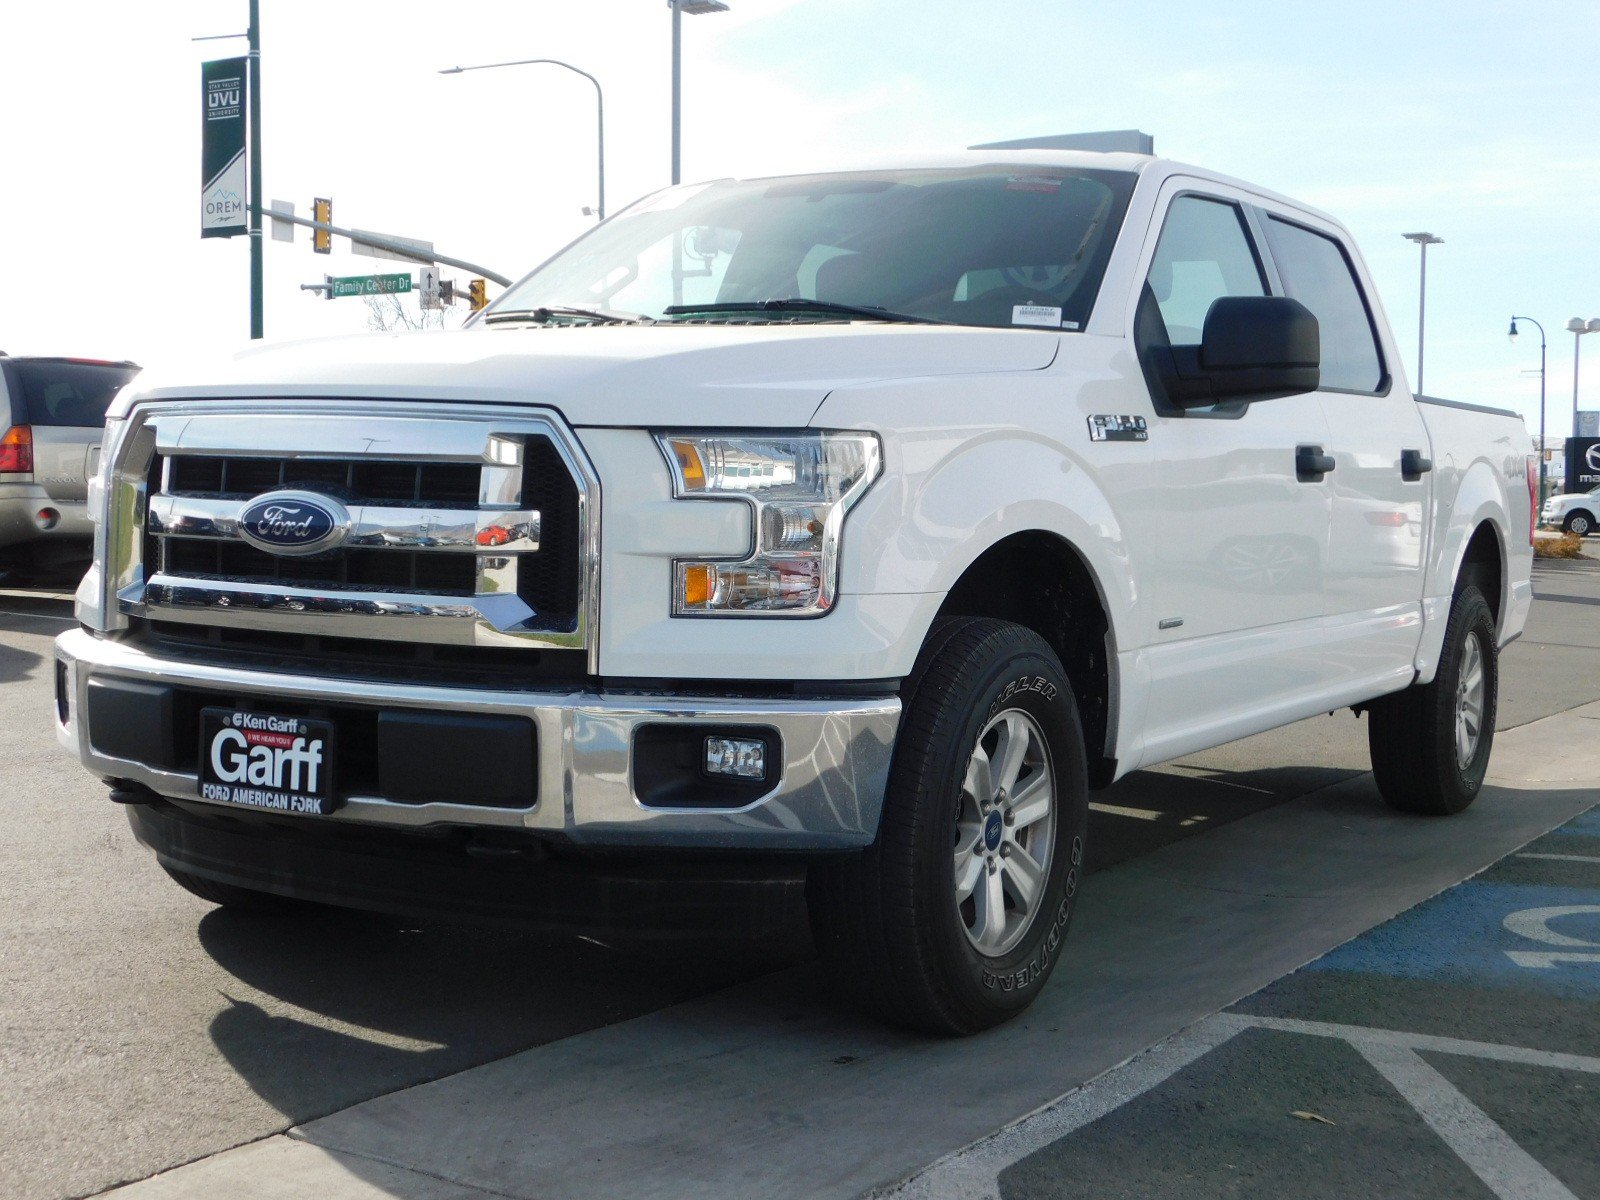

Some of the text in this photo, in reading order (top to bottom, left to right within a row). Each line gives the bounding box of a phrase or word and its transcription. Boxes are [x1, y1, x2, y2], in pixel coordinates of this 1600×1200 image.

[208, 90, 240, 108] UVU
[206, 200, 241, 215] OREM
[334, 277, 409, 295] Family Center Dr
[257, 505, 314, 537] Ford
[243, 713, 298, 733] Ken Garff
[260, 735, 276, 743] HEAR
[276, 737, 288, 745] YOU
[211, 728, 322, 793] Garff
[202, 783, 322, 814] FORD AMERICAN FORK
[983, 836, 1083, 991] GOODYEAR
